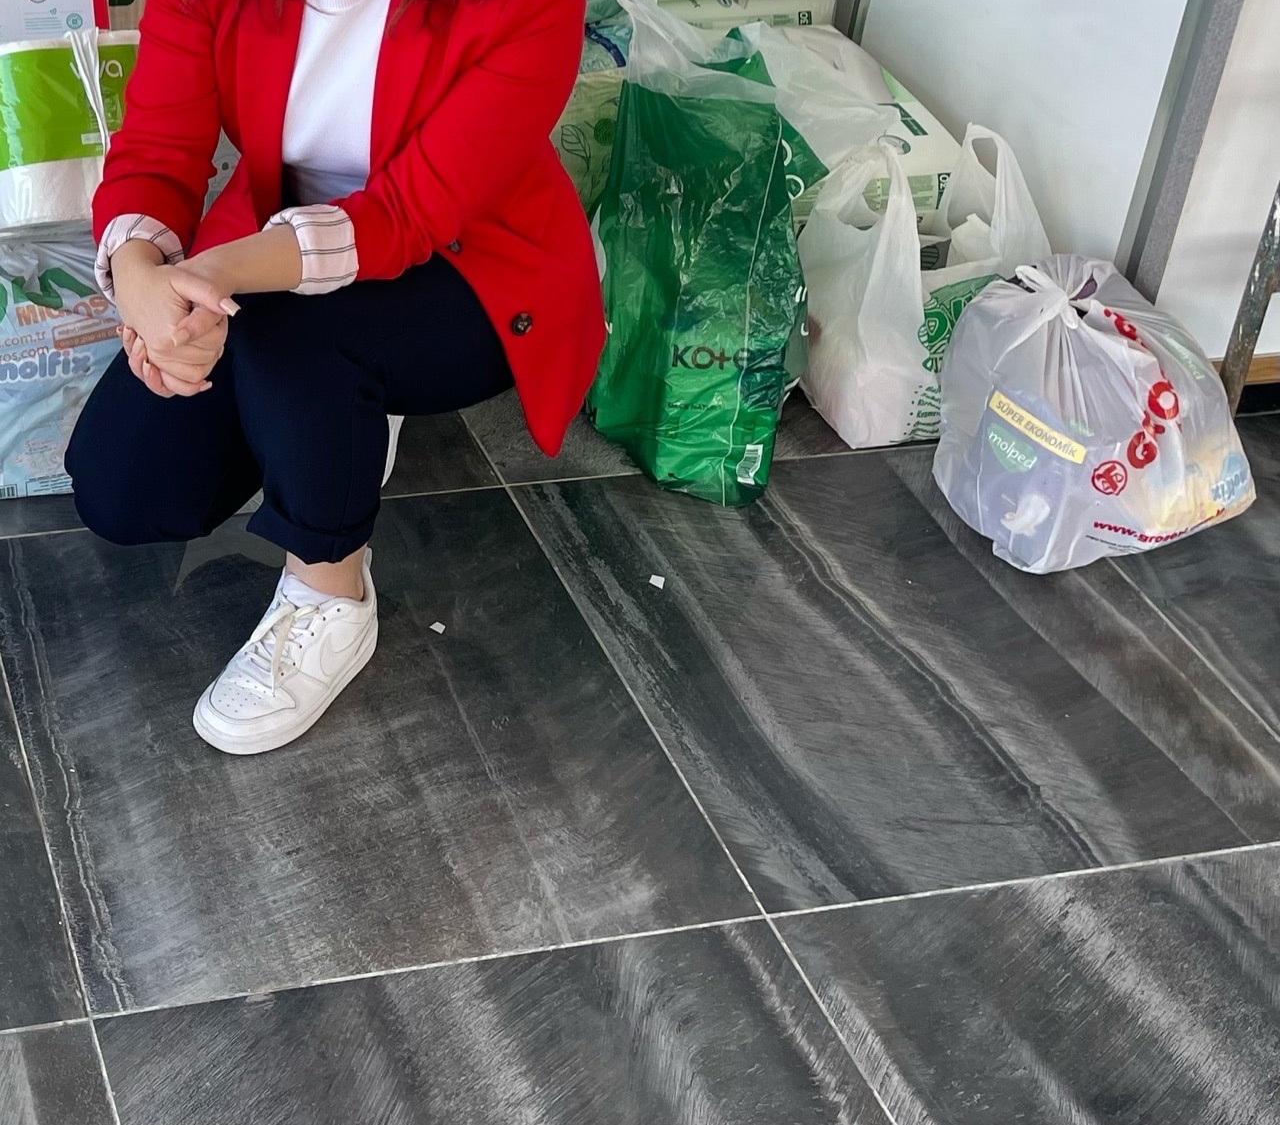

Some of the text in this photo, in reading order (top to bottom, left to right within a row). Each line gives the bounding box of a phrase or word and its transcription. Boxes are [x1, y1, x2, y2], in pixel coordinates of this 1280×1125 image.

[799, 11, 809, 25] 30
[995, 399, 1078, 459] SÜPER EKONOMİK
[988, 430, 1038, 471] molped
